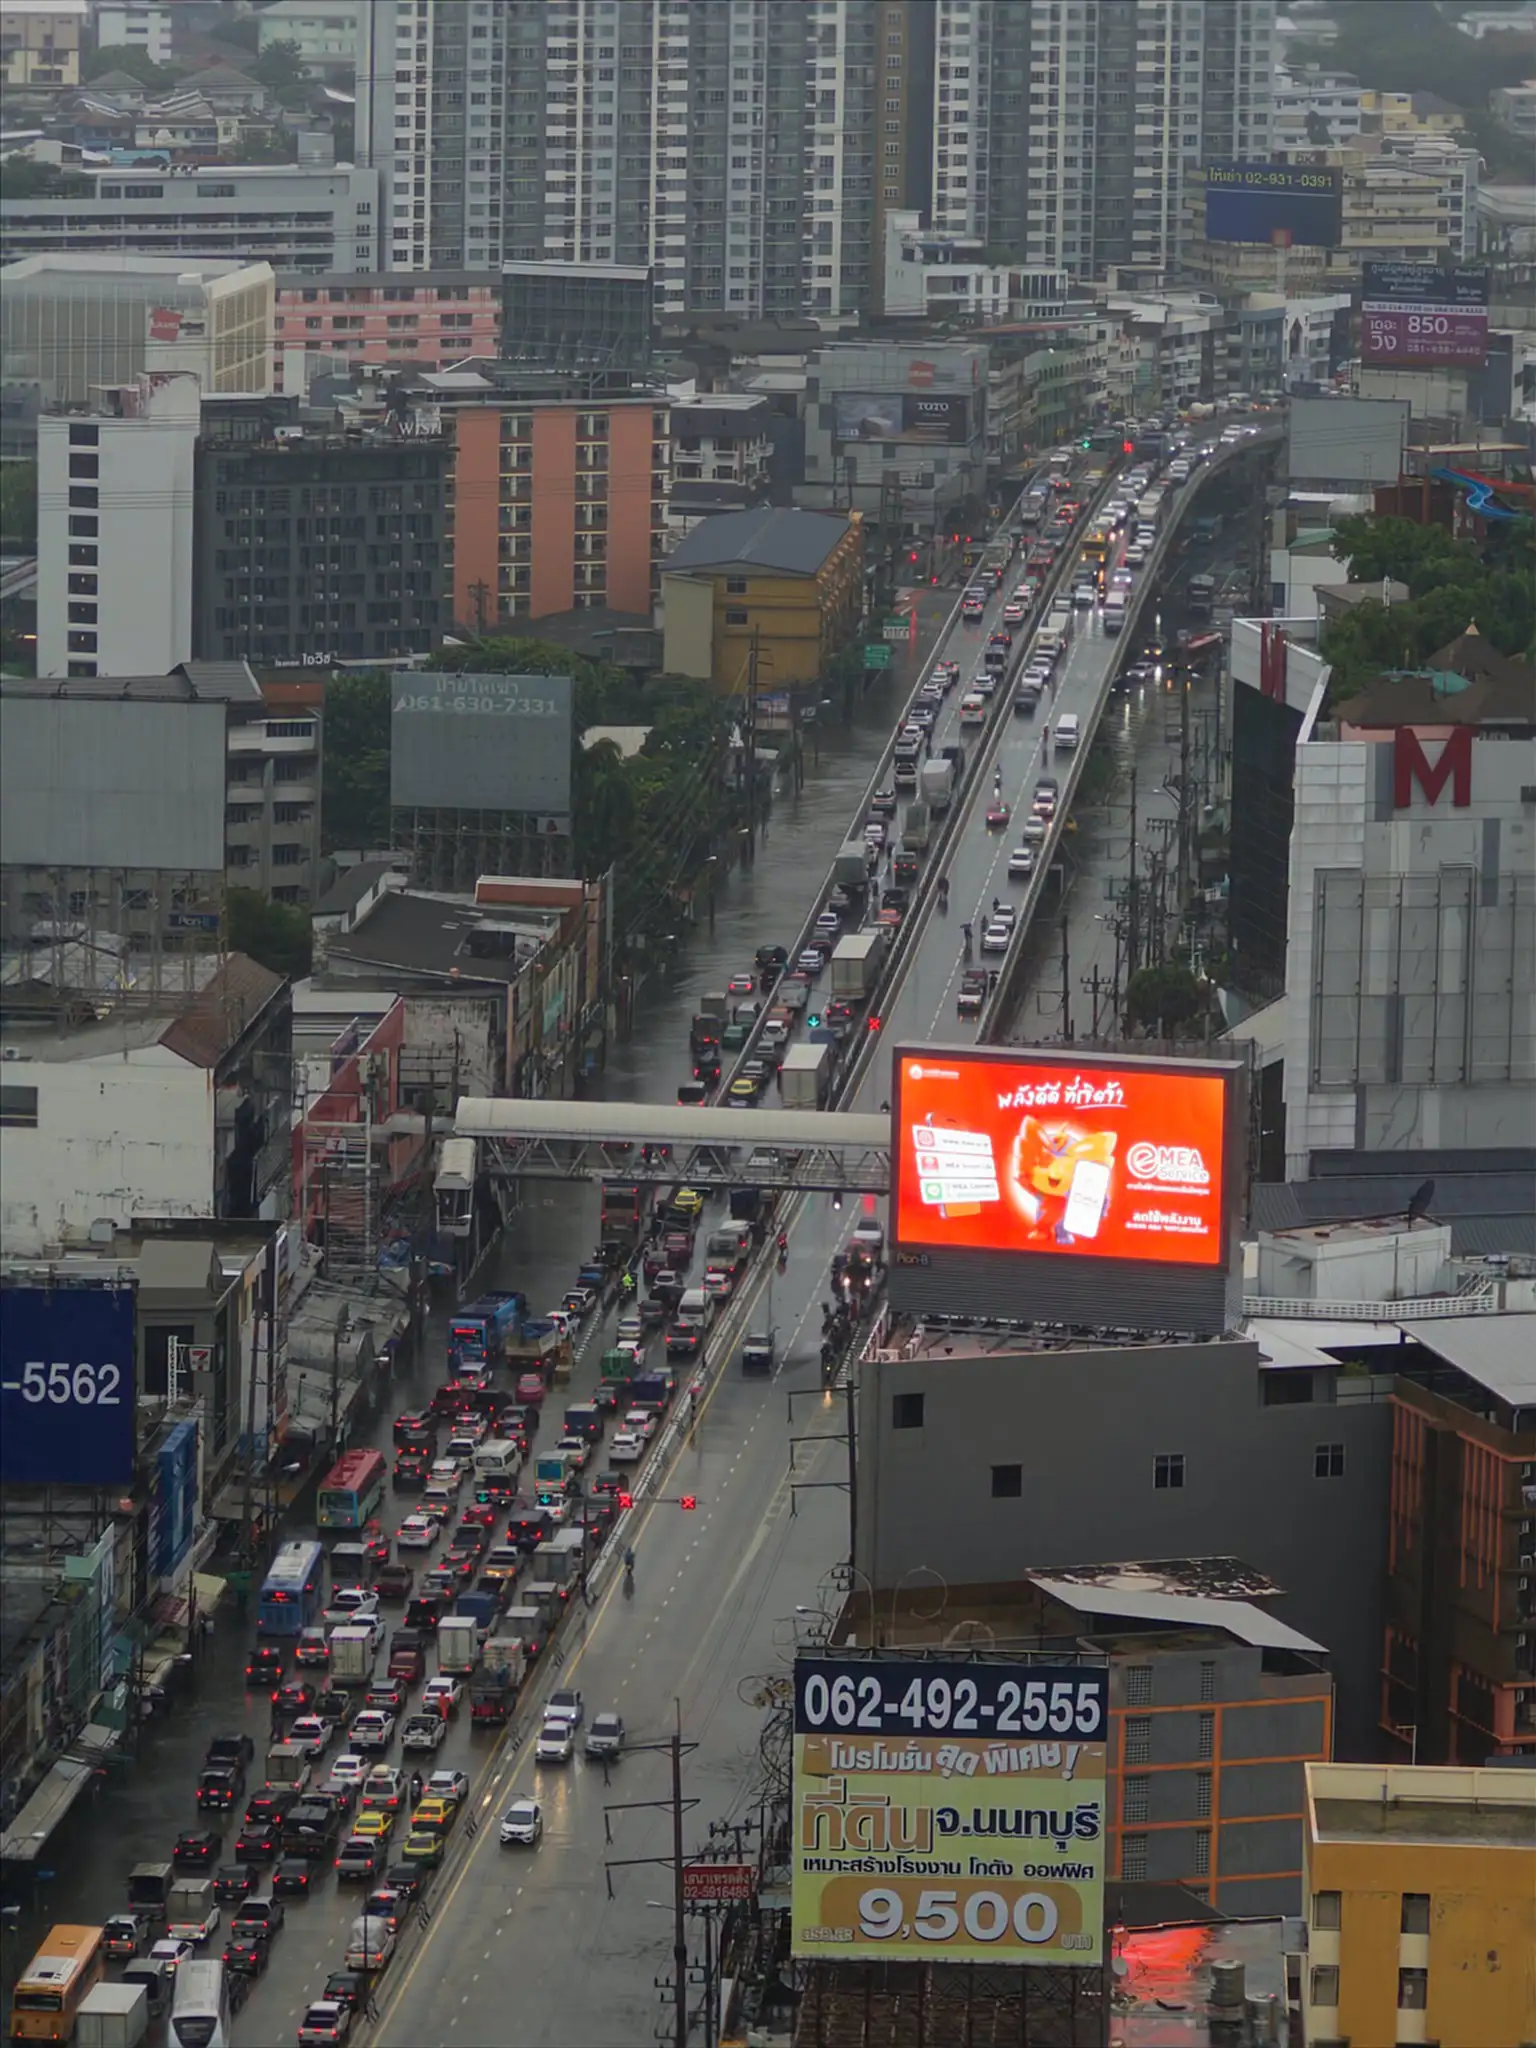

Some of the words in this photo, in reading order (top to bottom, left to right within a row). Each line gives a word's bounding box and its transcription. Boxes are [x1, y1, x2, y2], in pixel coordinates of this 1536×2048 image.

[915, 402, 949, 412] TOTO
[1394, 727, 1473, 809] M
[1159, 1149, 1201, 1167] MEA
[1159, 1165, 1208, 1180] Service
[2, 1361, 121, 1405] -5562
[804, 1673, 1101, 1734] 062-492-2555
[831, 1739, 932, 1772] โปรโมชั่น
[935, 1743, 980, 1779] สุด
[802, 1775, 934, 1854] ที่ดิน
[935, 1801, 1101, 1853] จ.นนทบุรี
[803, 1855, 962, 1876] เหมาะสร้างโรงงาน
[969, 1857, 1014, 1877] โกดัง
[1023, 1861, 1095, 1880] ออฟฟิศ
[683, 1885, 750, 1898] 02-5916485
[858, 1888, 1059, 1944] 9,500
